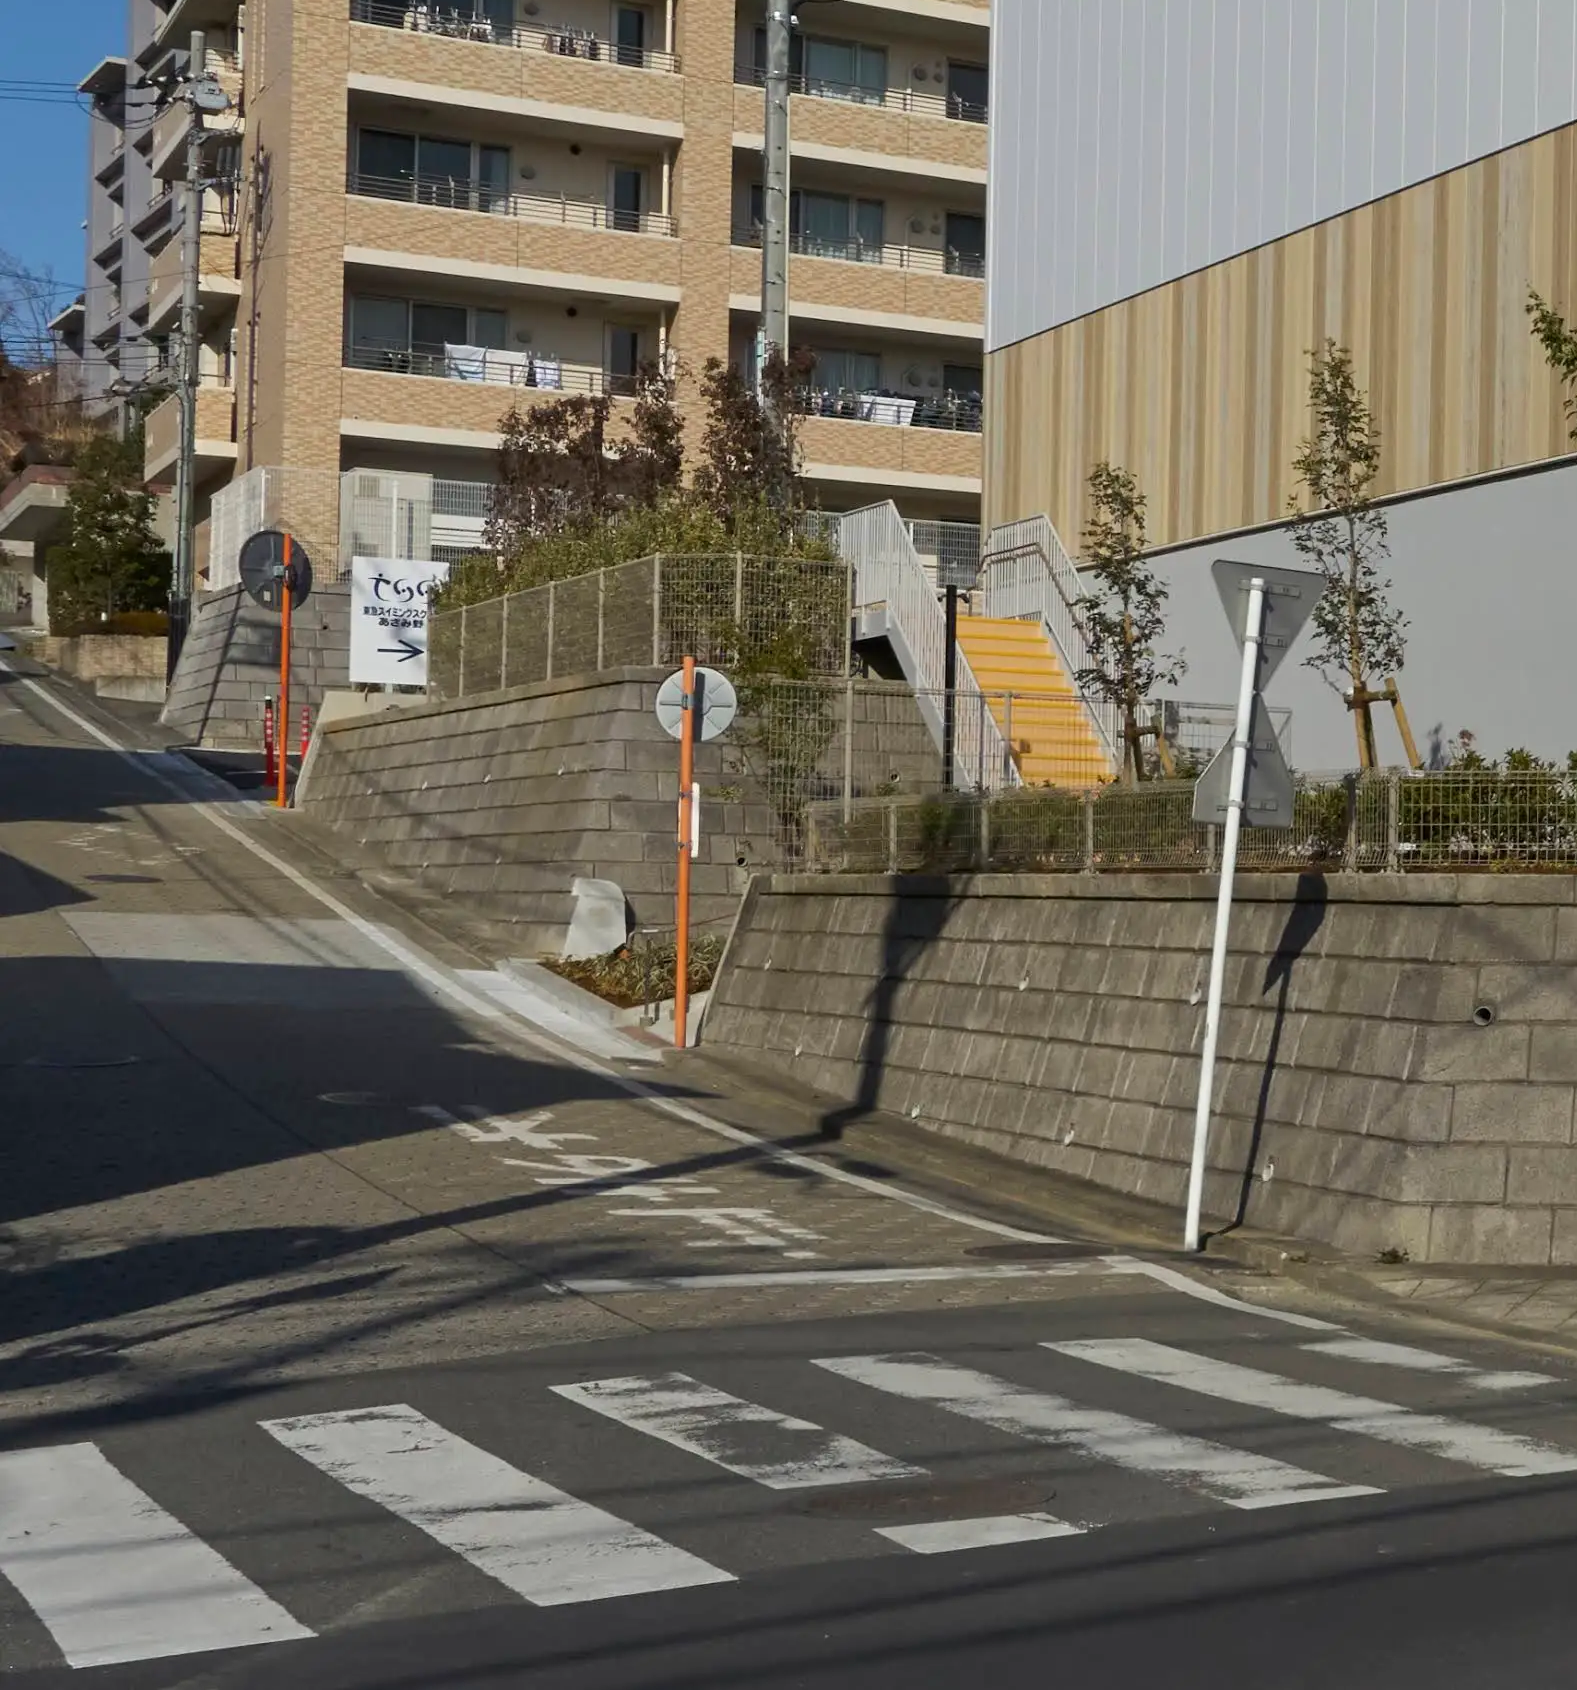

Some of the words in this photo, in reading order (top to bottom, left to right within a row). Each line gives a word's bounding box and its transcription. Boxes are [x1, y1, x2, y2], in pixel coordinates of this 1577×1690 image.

[363, 606, 427, 619] 東急スイミングスク
